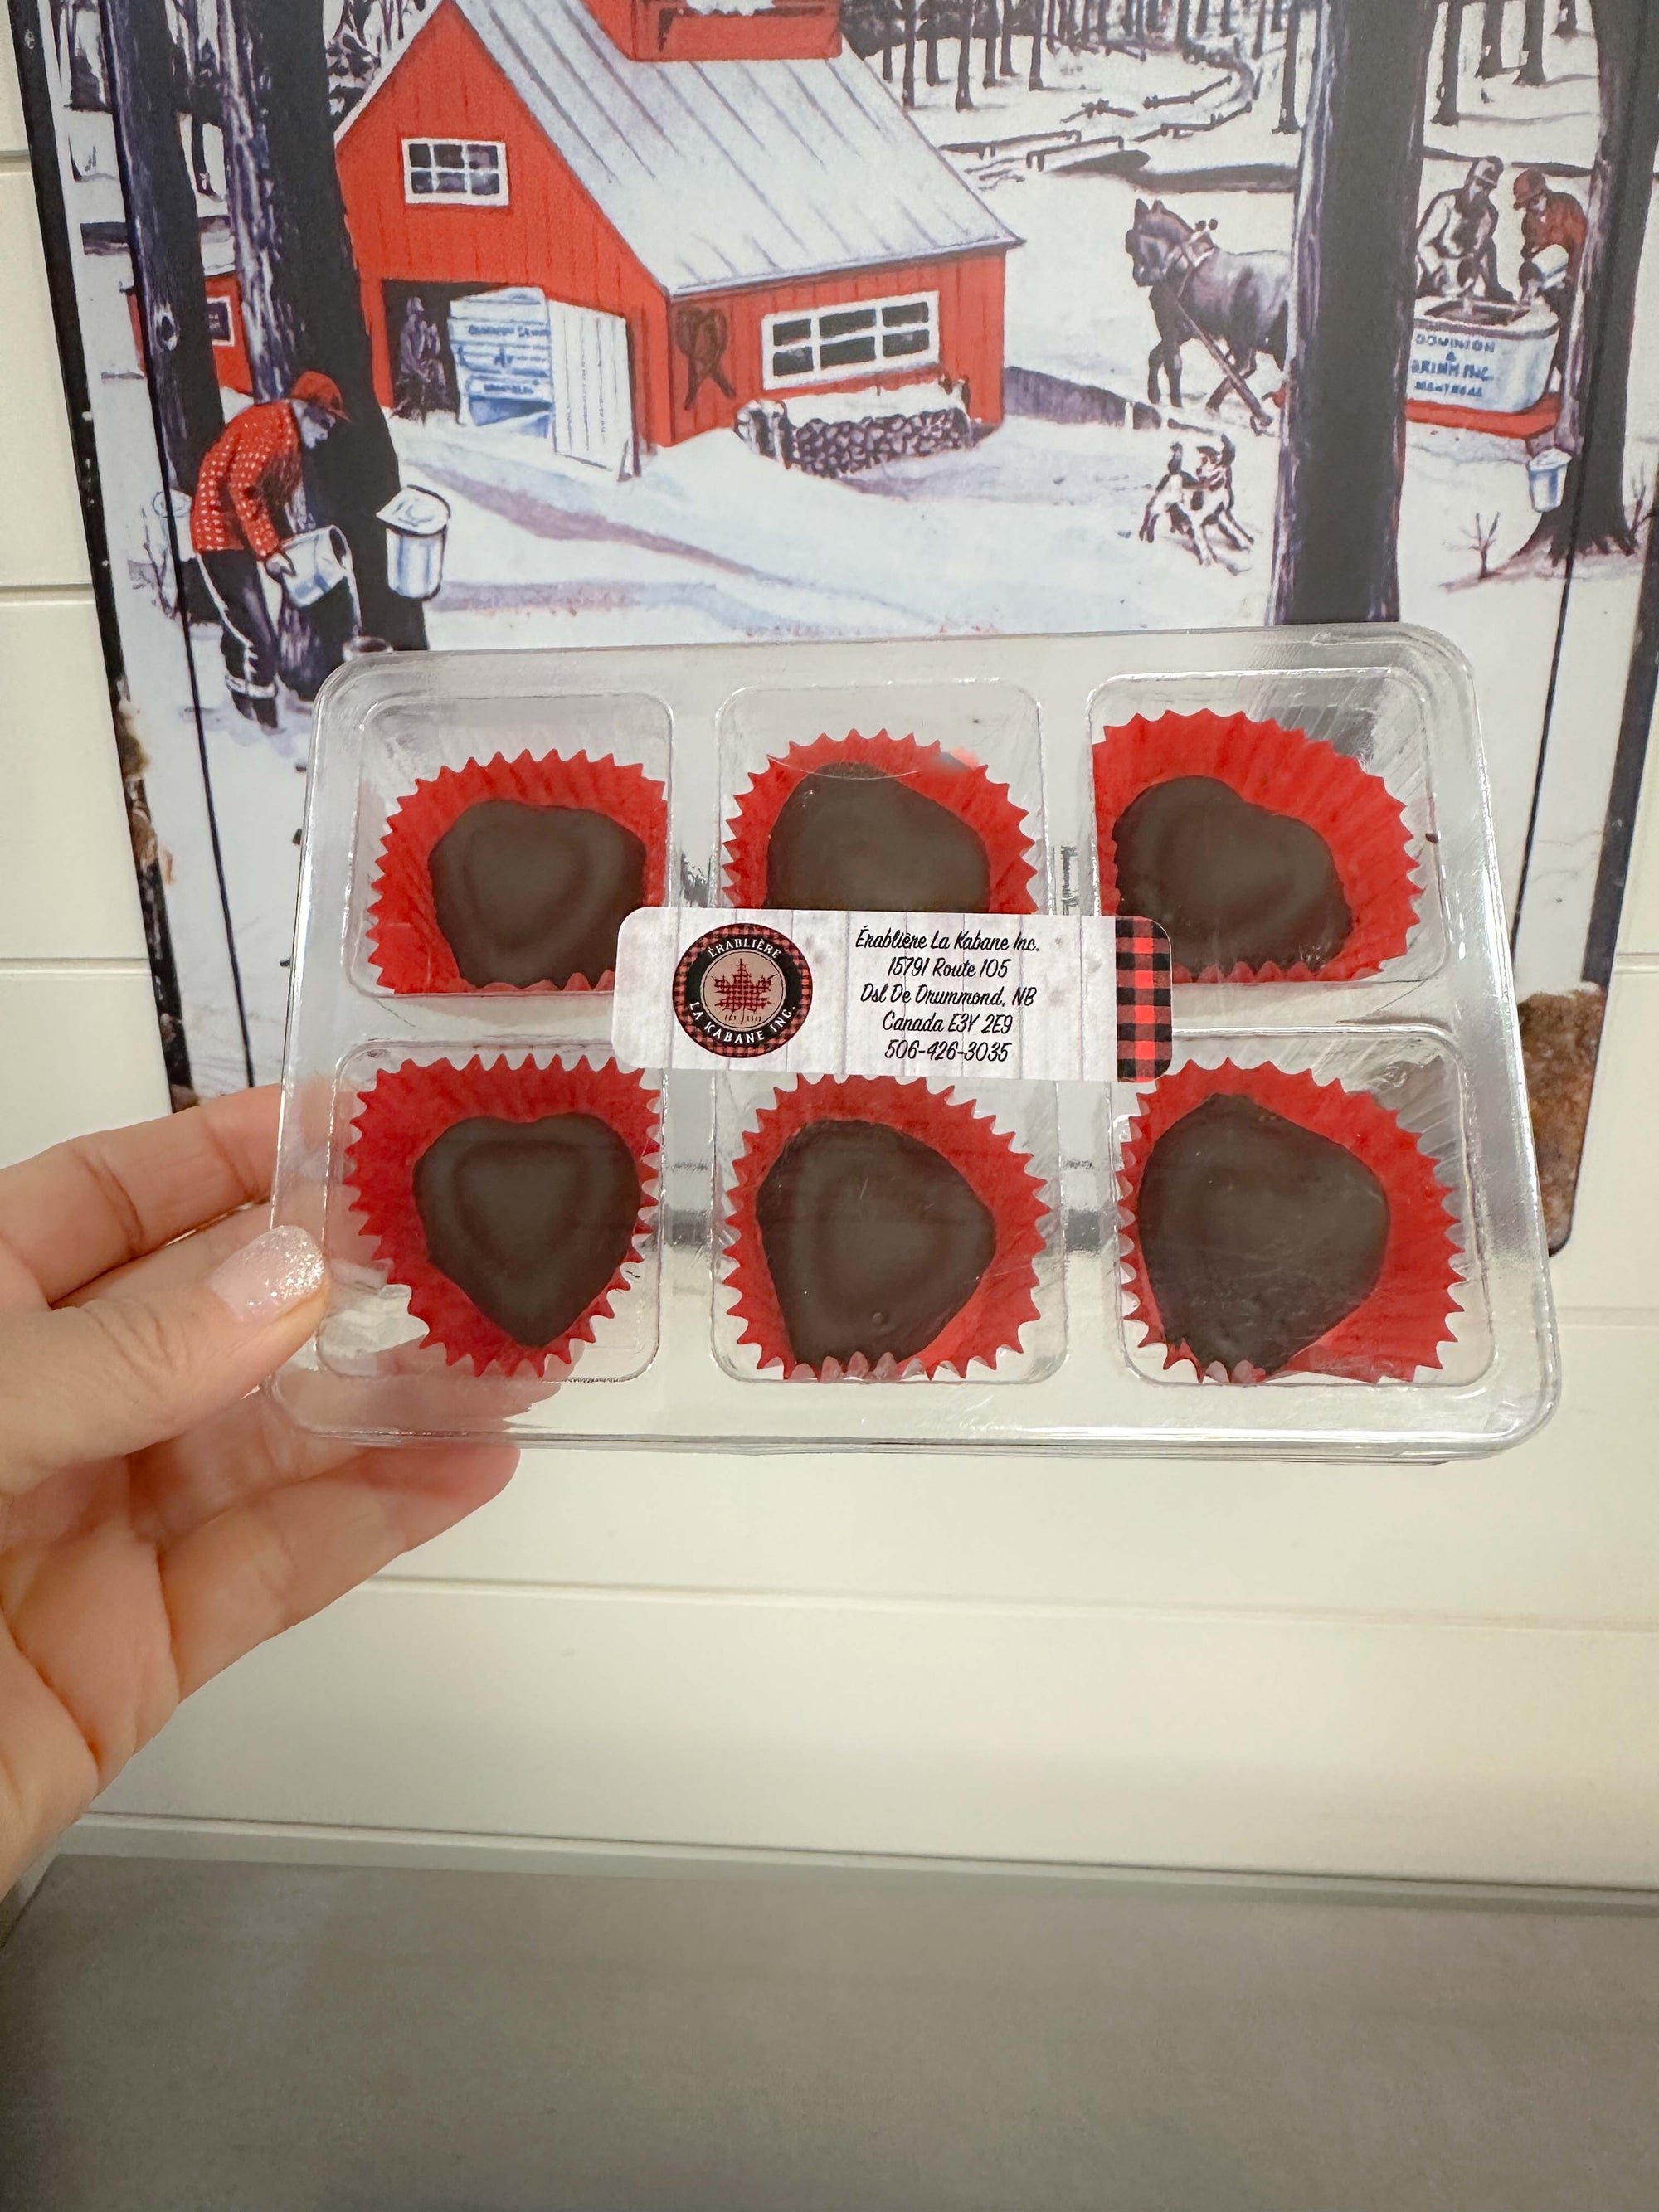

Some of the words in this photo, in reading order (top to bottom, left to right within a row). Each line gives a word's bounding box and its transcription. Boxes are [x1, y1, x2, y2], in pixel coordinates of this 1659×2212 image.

[708, 938, 781, 959] ÉRABLIÈRE
[855, 925, 927, 949] Érablière
[931, 930, 951, 950] La
[954, 930, 1010, 950] Kabane
[1013, 931, 1039, 951] Inc.
[888, 956, 930, 976] 15791
[932, 957, 976, 978] Route
[980, 958, 1012, 978] 105
[891, 983, 912, 1004] De
[915, 984, 1005, 1007] Drummond,
[1012, 986, 1037, 1006] NB
[689, 1001, 701, 1021] LA
[704, 1021, 765, 1044] KABANE
[770, 1006, 796, 1033] INC.
[883, 1010, 946, 1032] Canada
[947, 1013, 980, 1033] E3Y
[980, 1014, 1014, 1034] 2E9
[884, 1039, 1013, 1062] 506-426-3035
